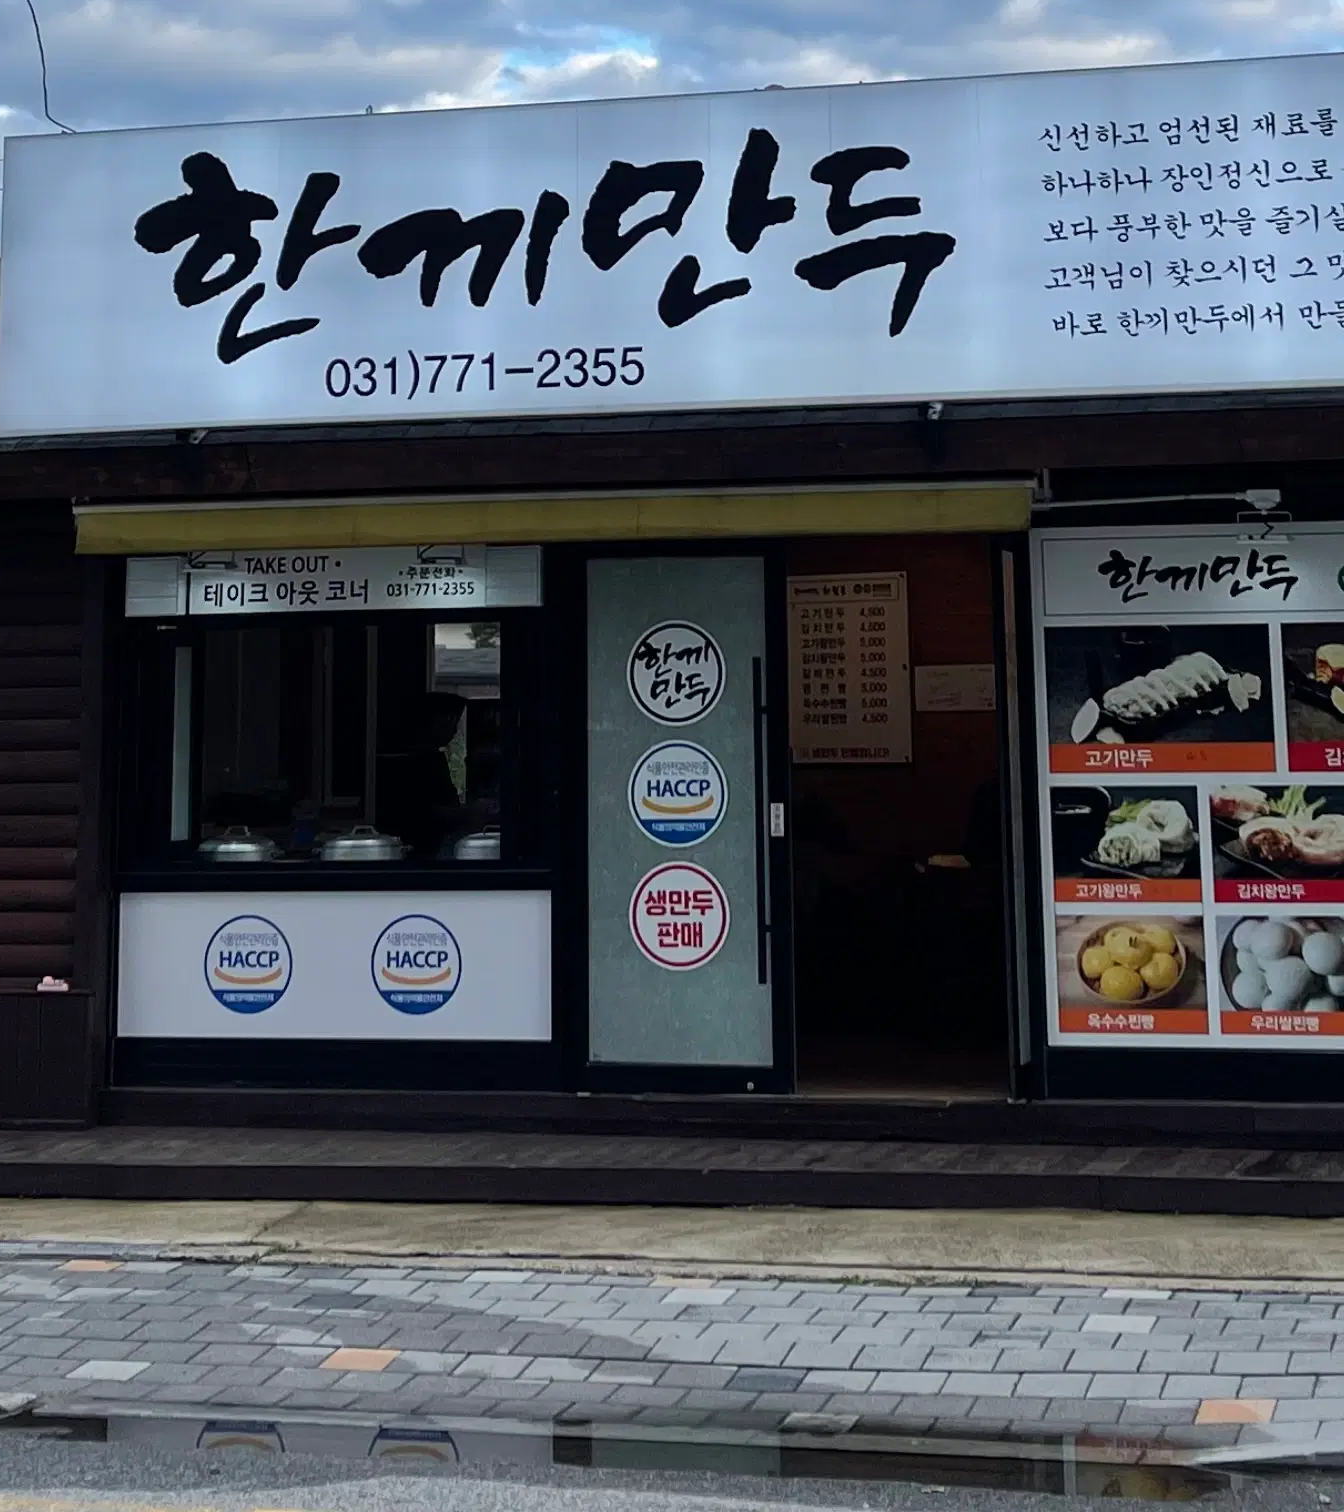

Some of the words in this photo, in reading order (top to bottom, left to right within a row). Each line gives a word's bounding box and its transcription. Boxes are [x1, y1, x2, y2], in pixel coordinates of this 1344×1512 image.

[1039, 121, 1149, 151] 신선하고
[1159, 114, 1238, 145] 엄선된
[1253, 108, 1337, 138] 재료를
[1042, 166, 1152, 196] 하나하나
[1161, 159, 1332, 192] 장인정신으로
[1044, 216, 1098, 242] 보다
[1107, 211, 1191, 242] 풍부한
[1200, 208, 1256, 237] 맛을
[1045, 260, 1151, 290] 고객님이
[1167, 255, 1276, 286] 찾으시던
[1290, 257, 1317, 277] 그
[1053, 312, 1107, 337] 바로
[1117, 302, 1283, 336] 한끼만두에서
[326, 347, 644, 399] 031)771-2355
[244, 557, 286, 574] TAKE
[292, 556, 329, 572] OUT
[204, 583, 268, 607] 테이크
[277, 581, 319, 605] 아웃
[326, 579, 368, 604] 코너
[386, 581, 474, 598] 031-771-2355
[650, 672, 710, 708] 만두
[1085, 749, 1153, 768] 고기만두
[648, 780, 711, 797] HACCP
[645, 890, 713, 915] 생만두
[1076, 884, 1142, 899] 고기왕만두
[1238, 884, 1305, 899] 김치왕만두
[658, 922, 702, 947] 판매
[219, 951, 280, 968] HACCP
[387, 951, 448, 968] HACCP
